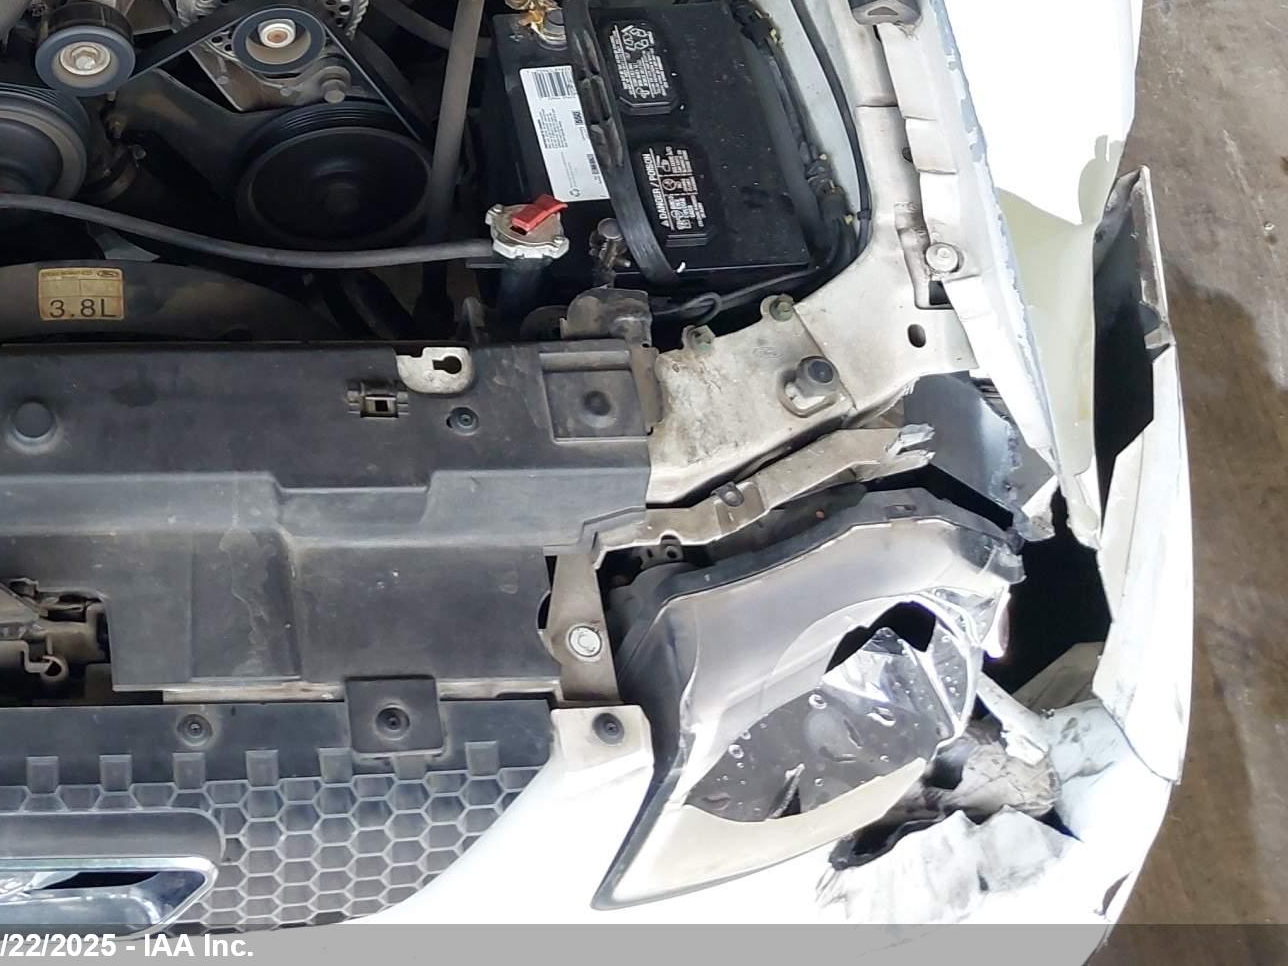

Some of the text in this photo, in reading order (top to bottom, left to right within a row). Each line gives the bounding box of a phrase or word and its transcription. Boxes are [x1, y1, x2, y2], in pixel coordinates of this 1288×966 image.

[641, 153, 656, 182] POISON
[652, 188, 669, 220] DANGER
[48, 298, 117, 319] 3.8L
